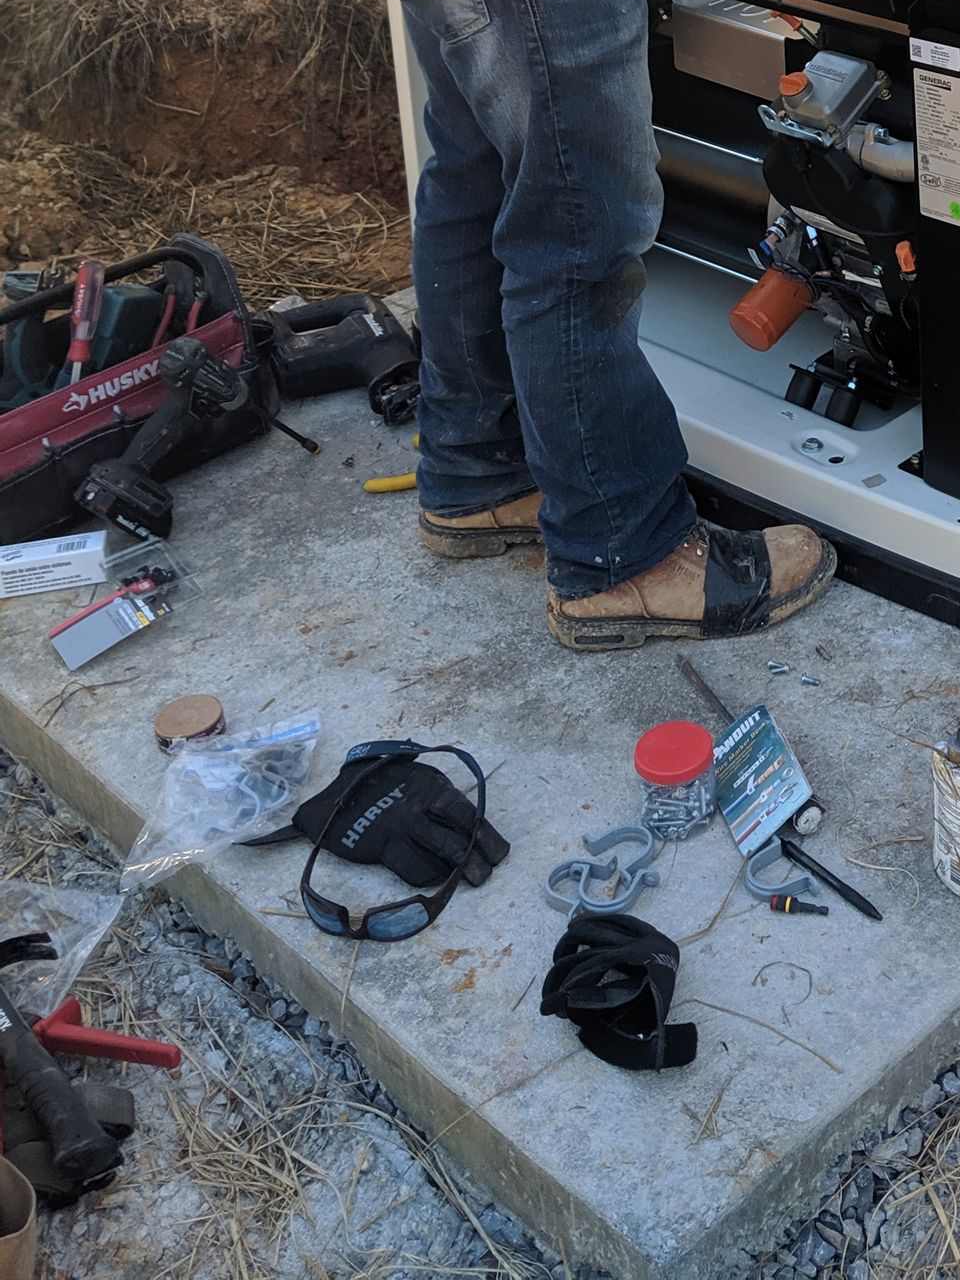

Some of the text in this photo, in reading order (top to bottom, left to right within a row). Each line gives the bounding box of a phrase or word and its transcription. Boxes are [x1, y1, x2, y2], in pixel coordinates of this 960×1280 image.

[919, 74, 952, 88] GENERAC
[88, 360, 160, 404] HUSKY
[713, 710, 761, 765] PANDUIT
[341, 787, 404, 850] HARDY
